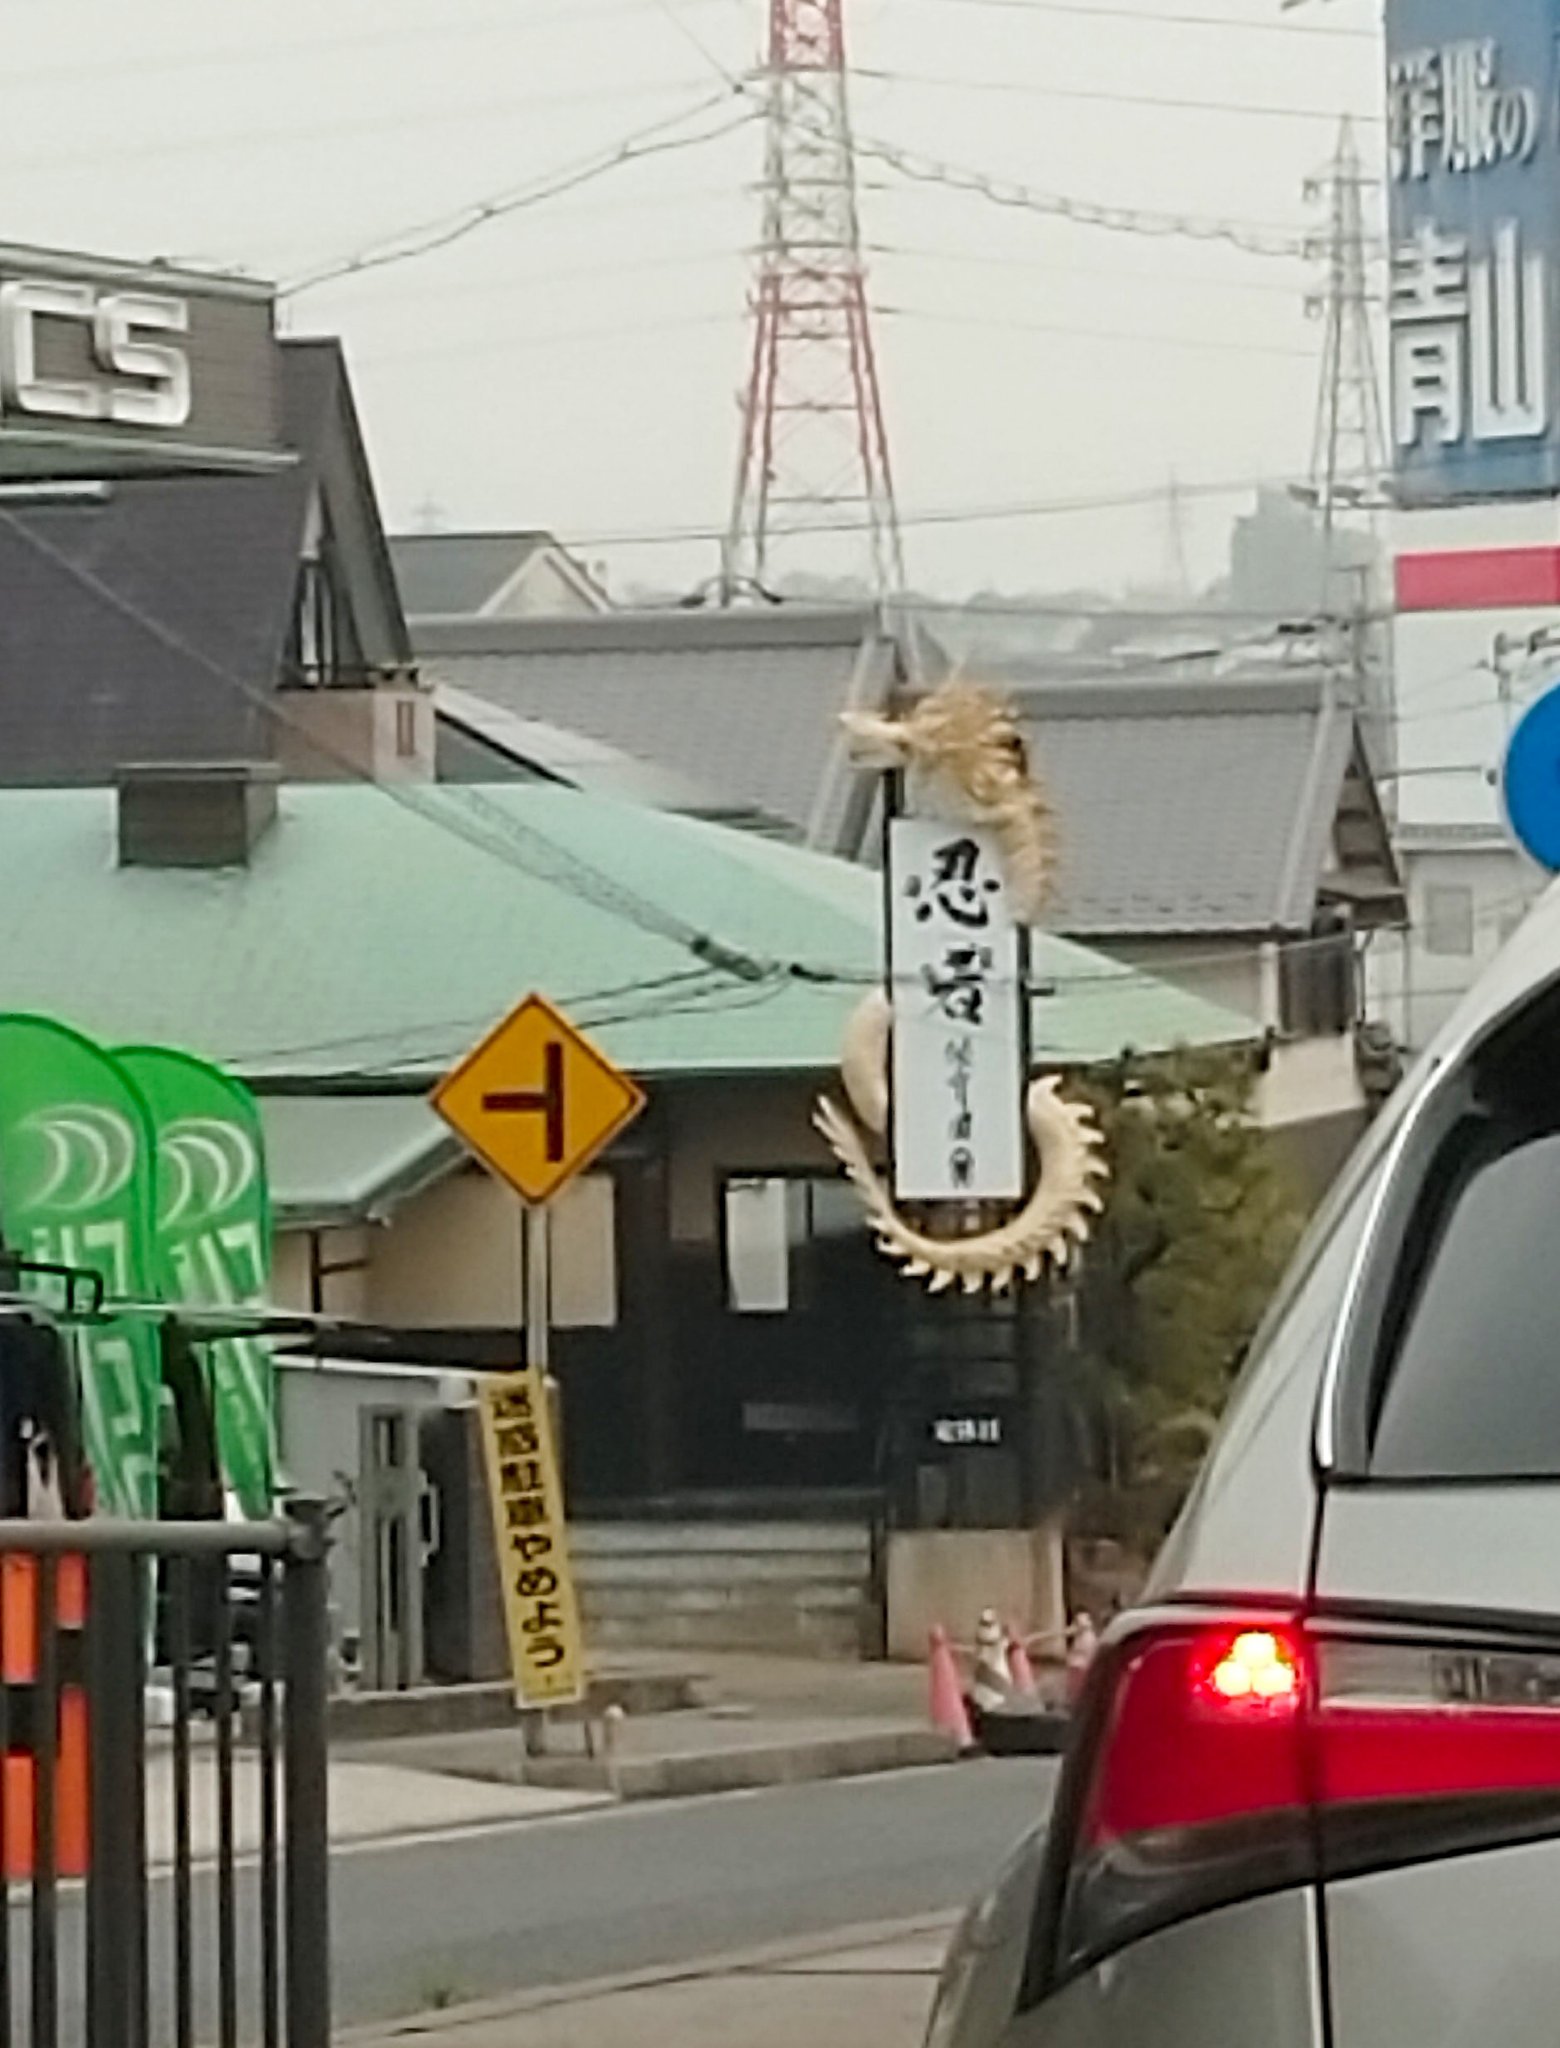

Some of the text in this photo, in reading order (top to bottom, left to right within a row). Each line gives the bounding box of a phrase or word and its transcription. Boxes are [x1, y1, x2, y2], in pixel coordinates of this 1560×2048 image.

[1388, 36, 1538, 180] 洋服の
[0, 279, 191, 426] CS
[1392, 216, 1546, 446] 青山
